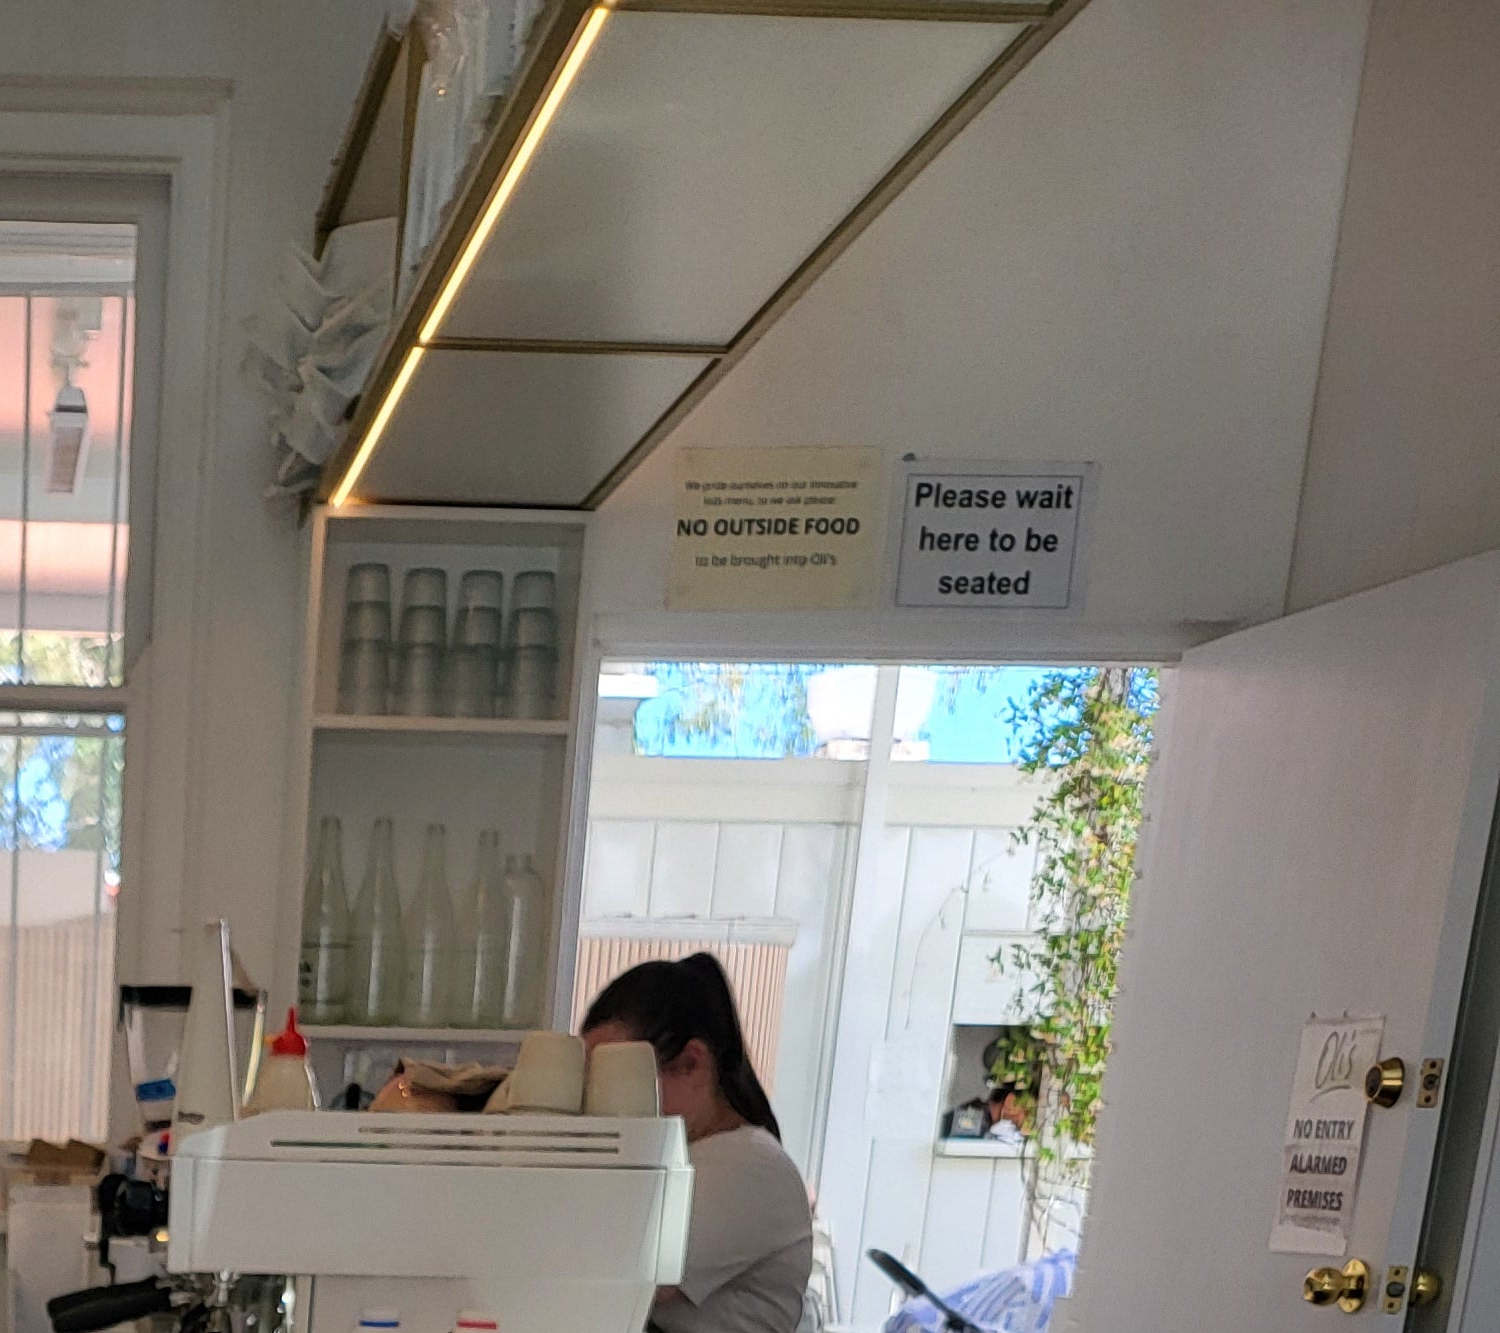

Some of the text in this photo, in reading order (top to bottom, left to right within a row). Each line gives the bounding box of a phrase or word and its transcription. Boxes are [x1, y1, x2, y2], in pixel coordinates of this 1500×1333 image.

[915, 483, 1074, 509] Please wait
[677, 517, 861, 536] NO OUTSIDE FOOD
[919, 525, 1059, 552] here to be
[938, 570, 1031, 595] seated
[1293, 1119, 1355, 1140] NO ENTRY
[1290, 1153, 1348, 1176] ALARMED
[1286, 1188, 1343, 1211] PREMISES
